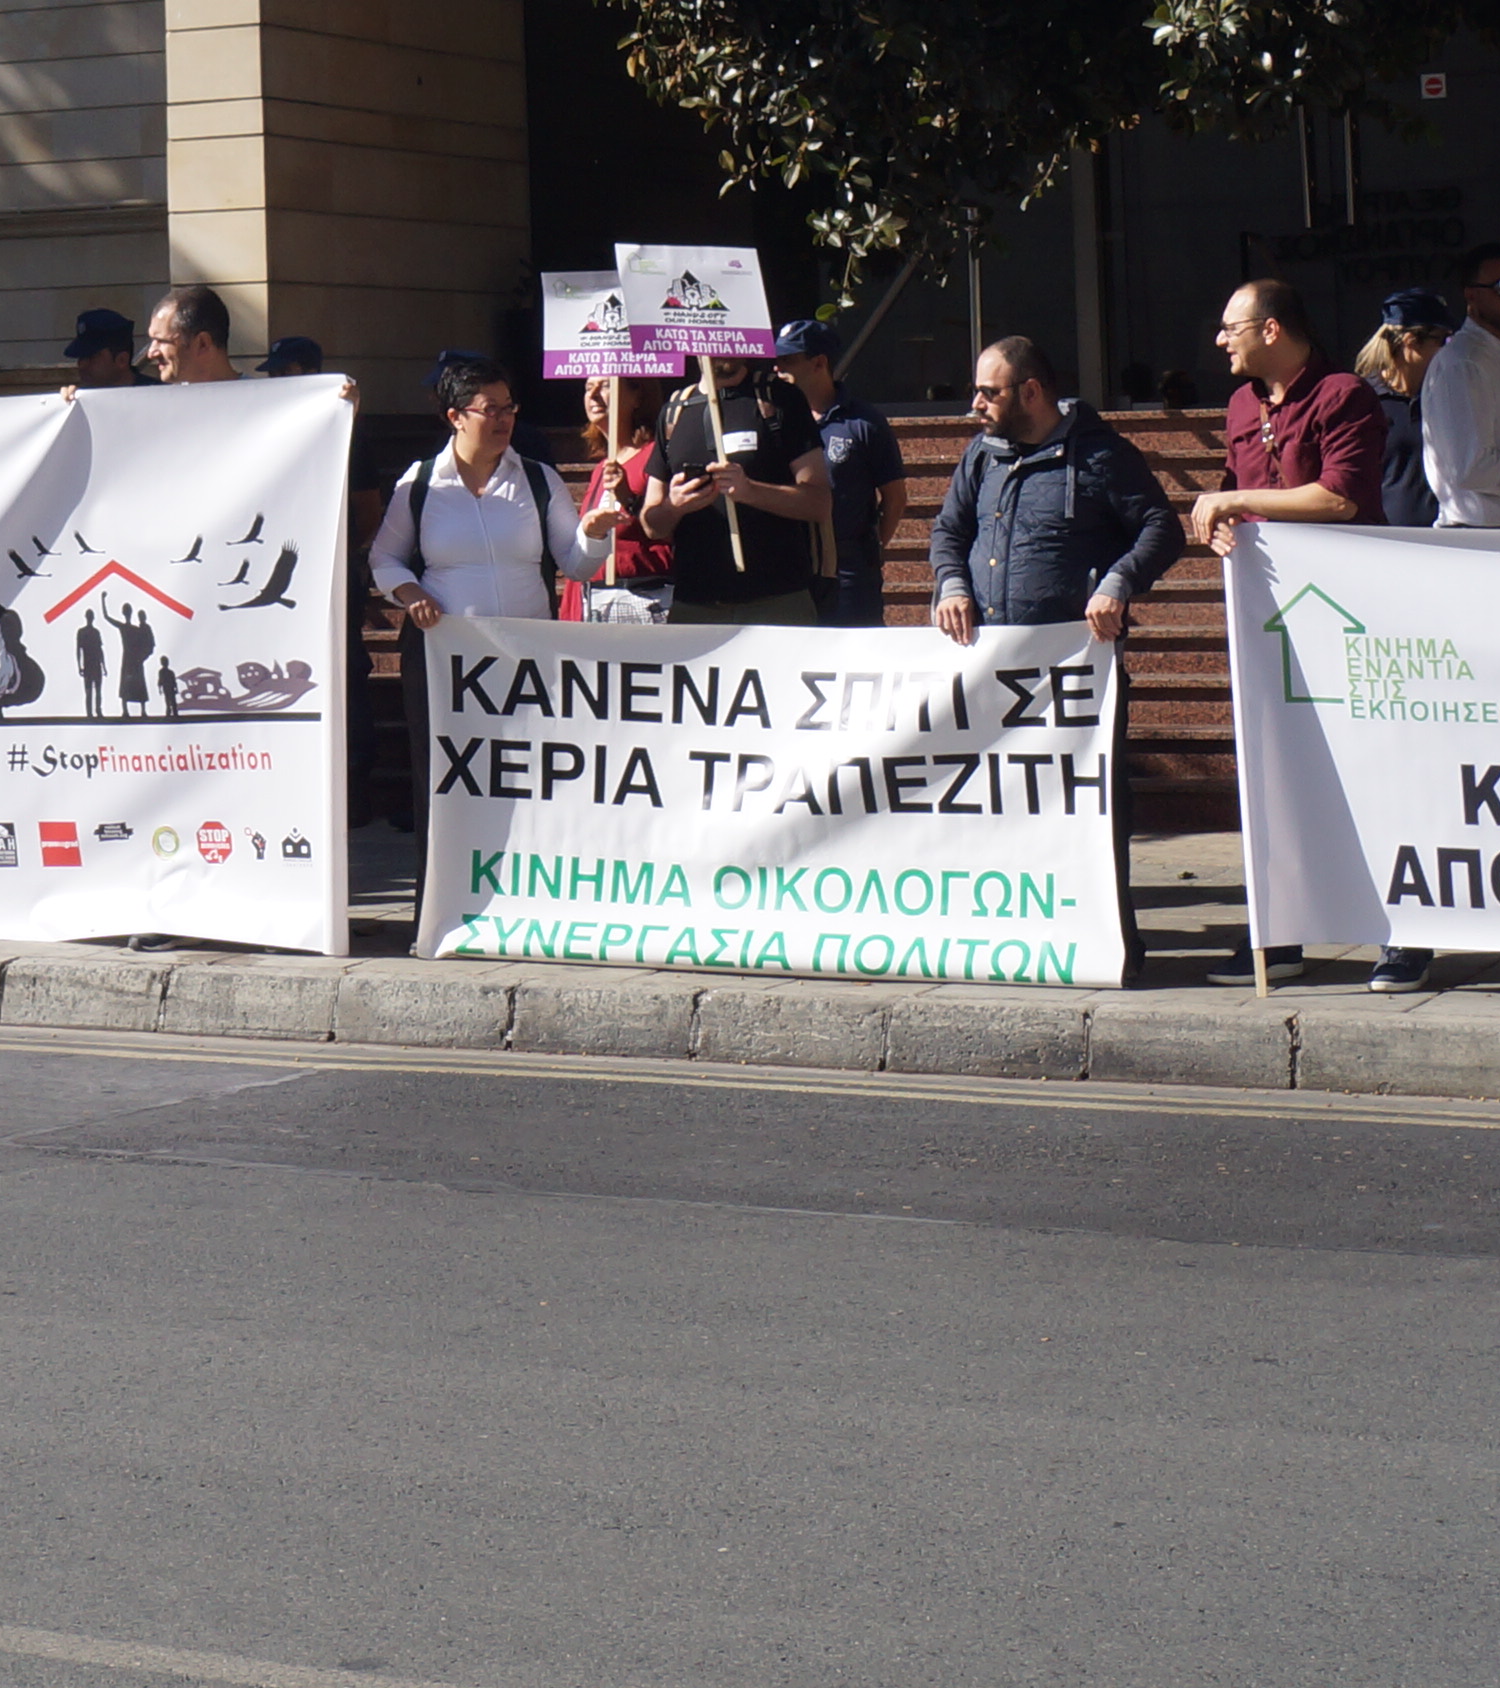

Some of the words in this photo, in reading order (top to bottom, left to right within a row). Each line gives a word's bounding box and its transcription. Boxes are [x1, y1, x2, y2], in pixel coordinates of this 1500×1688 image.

[655, 328, 688, 340] ΚΑΤΩ
[690, 329, 706, 340] ΤΑ
[708, 329, 746, 342] ΧΕΡΙΑ
[569, 352, 601, 363] ΚΑΤΩ
[603, 352, 619, 362] ΤΑ
[643, 340, 672, 351] ΑΠΟ
[675, 341, 690, 352] ΤΑ
[692, 341, 732, 354] ΣΠΙΤΙΑ
[735, 342, 765, 355] ΜΑΣ
[555, 364, 583, 376] ΑΠΟ
[585, 364, 599, 375] ΤΑ
[601, 363, 648, 375] ΣΠΙΤΙΑ
[650, 363, 674, 374] ΜΑΣ
[1344, 636, 1460, 660] ΚΙΝΗΜΑ
[1346, 656, 1475, 681] ΕΝΑΝΤΙΑ
[449, 654, 772, 730] ΚΑΝΕΝΑ
[794, 669, 971, 733] ΣΠΙΤΙ
[994, 664, 1101, 729] ΣΕ
[1347, 677, 1407, 700] ΣΤΙΣ
[436, 733, 664, 809] ΧΕΡΙΑ
[688, 749, 1107, 817] ΤΡΑΠΕΖΙΤΗ
[199, 828, 229, 843] STOP
[469, 848, 692, 909] ΚΙΝΗΜΑ
[711, 864, 1077, 920] ΟΙΚΟΛΟΓΩΝ-
[453, 912, 792, 973] ΣΥΝΕΡΓΑΣΙΑ
[810, 931, 1077, 985] ΠΟΛΙΤΩΝ
